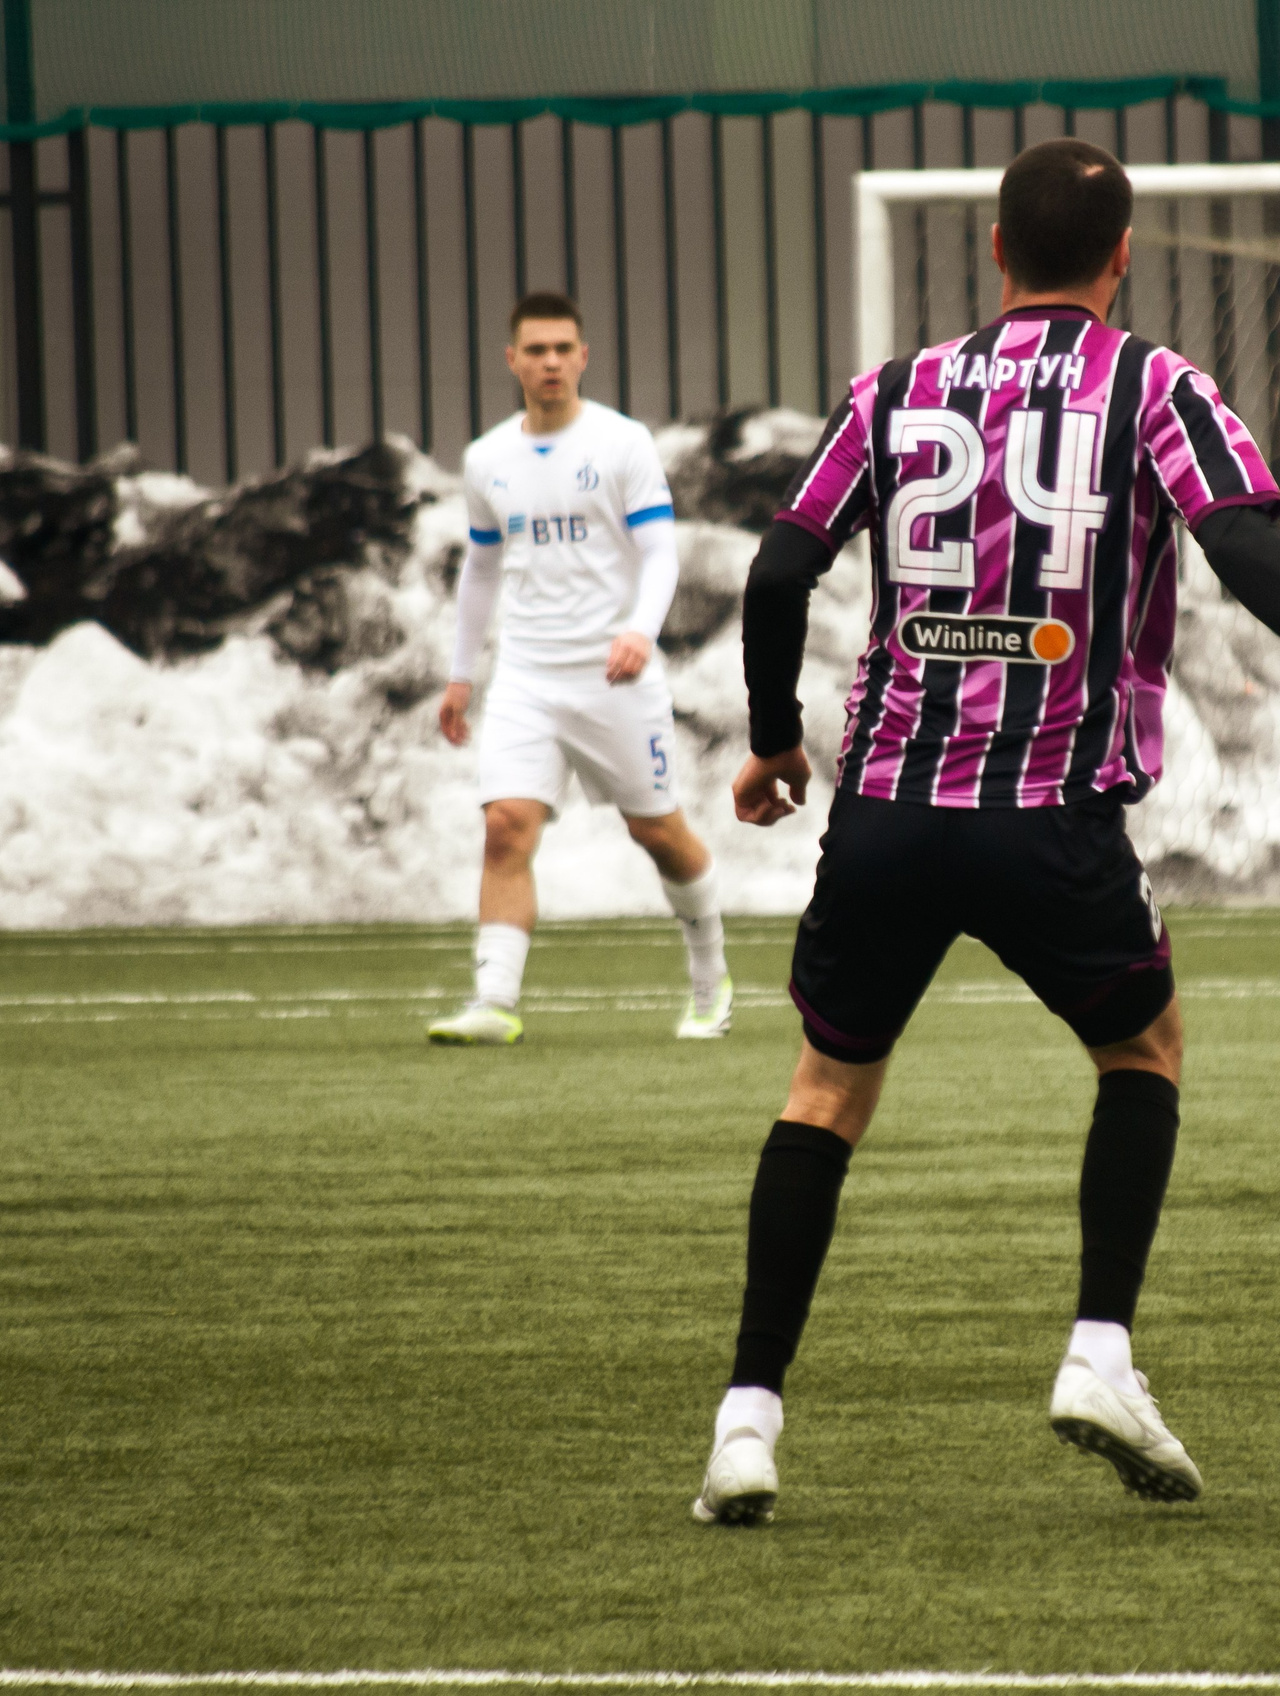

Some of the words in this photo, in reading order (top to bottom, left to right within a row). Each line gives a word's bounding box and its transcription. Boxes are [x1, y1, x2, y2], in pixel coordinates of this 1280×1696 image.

[937, 353, 1086, 391] МАРТУН
[887, 408, 1109, 590] 24
[532, 514, 588, 545] ВТБ
[913, 623, 1022, 651] Winline
[649, 733, 667, 776] 5
